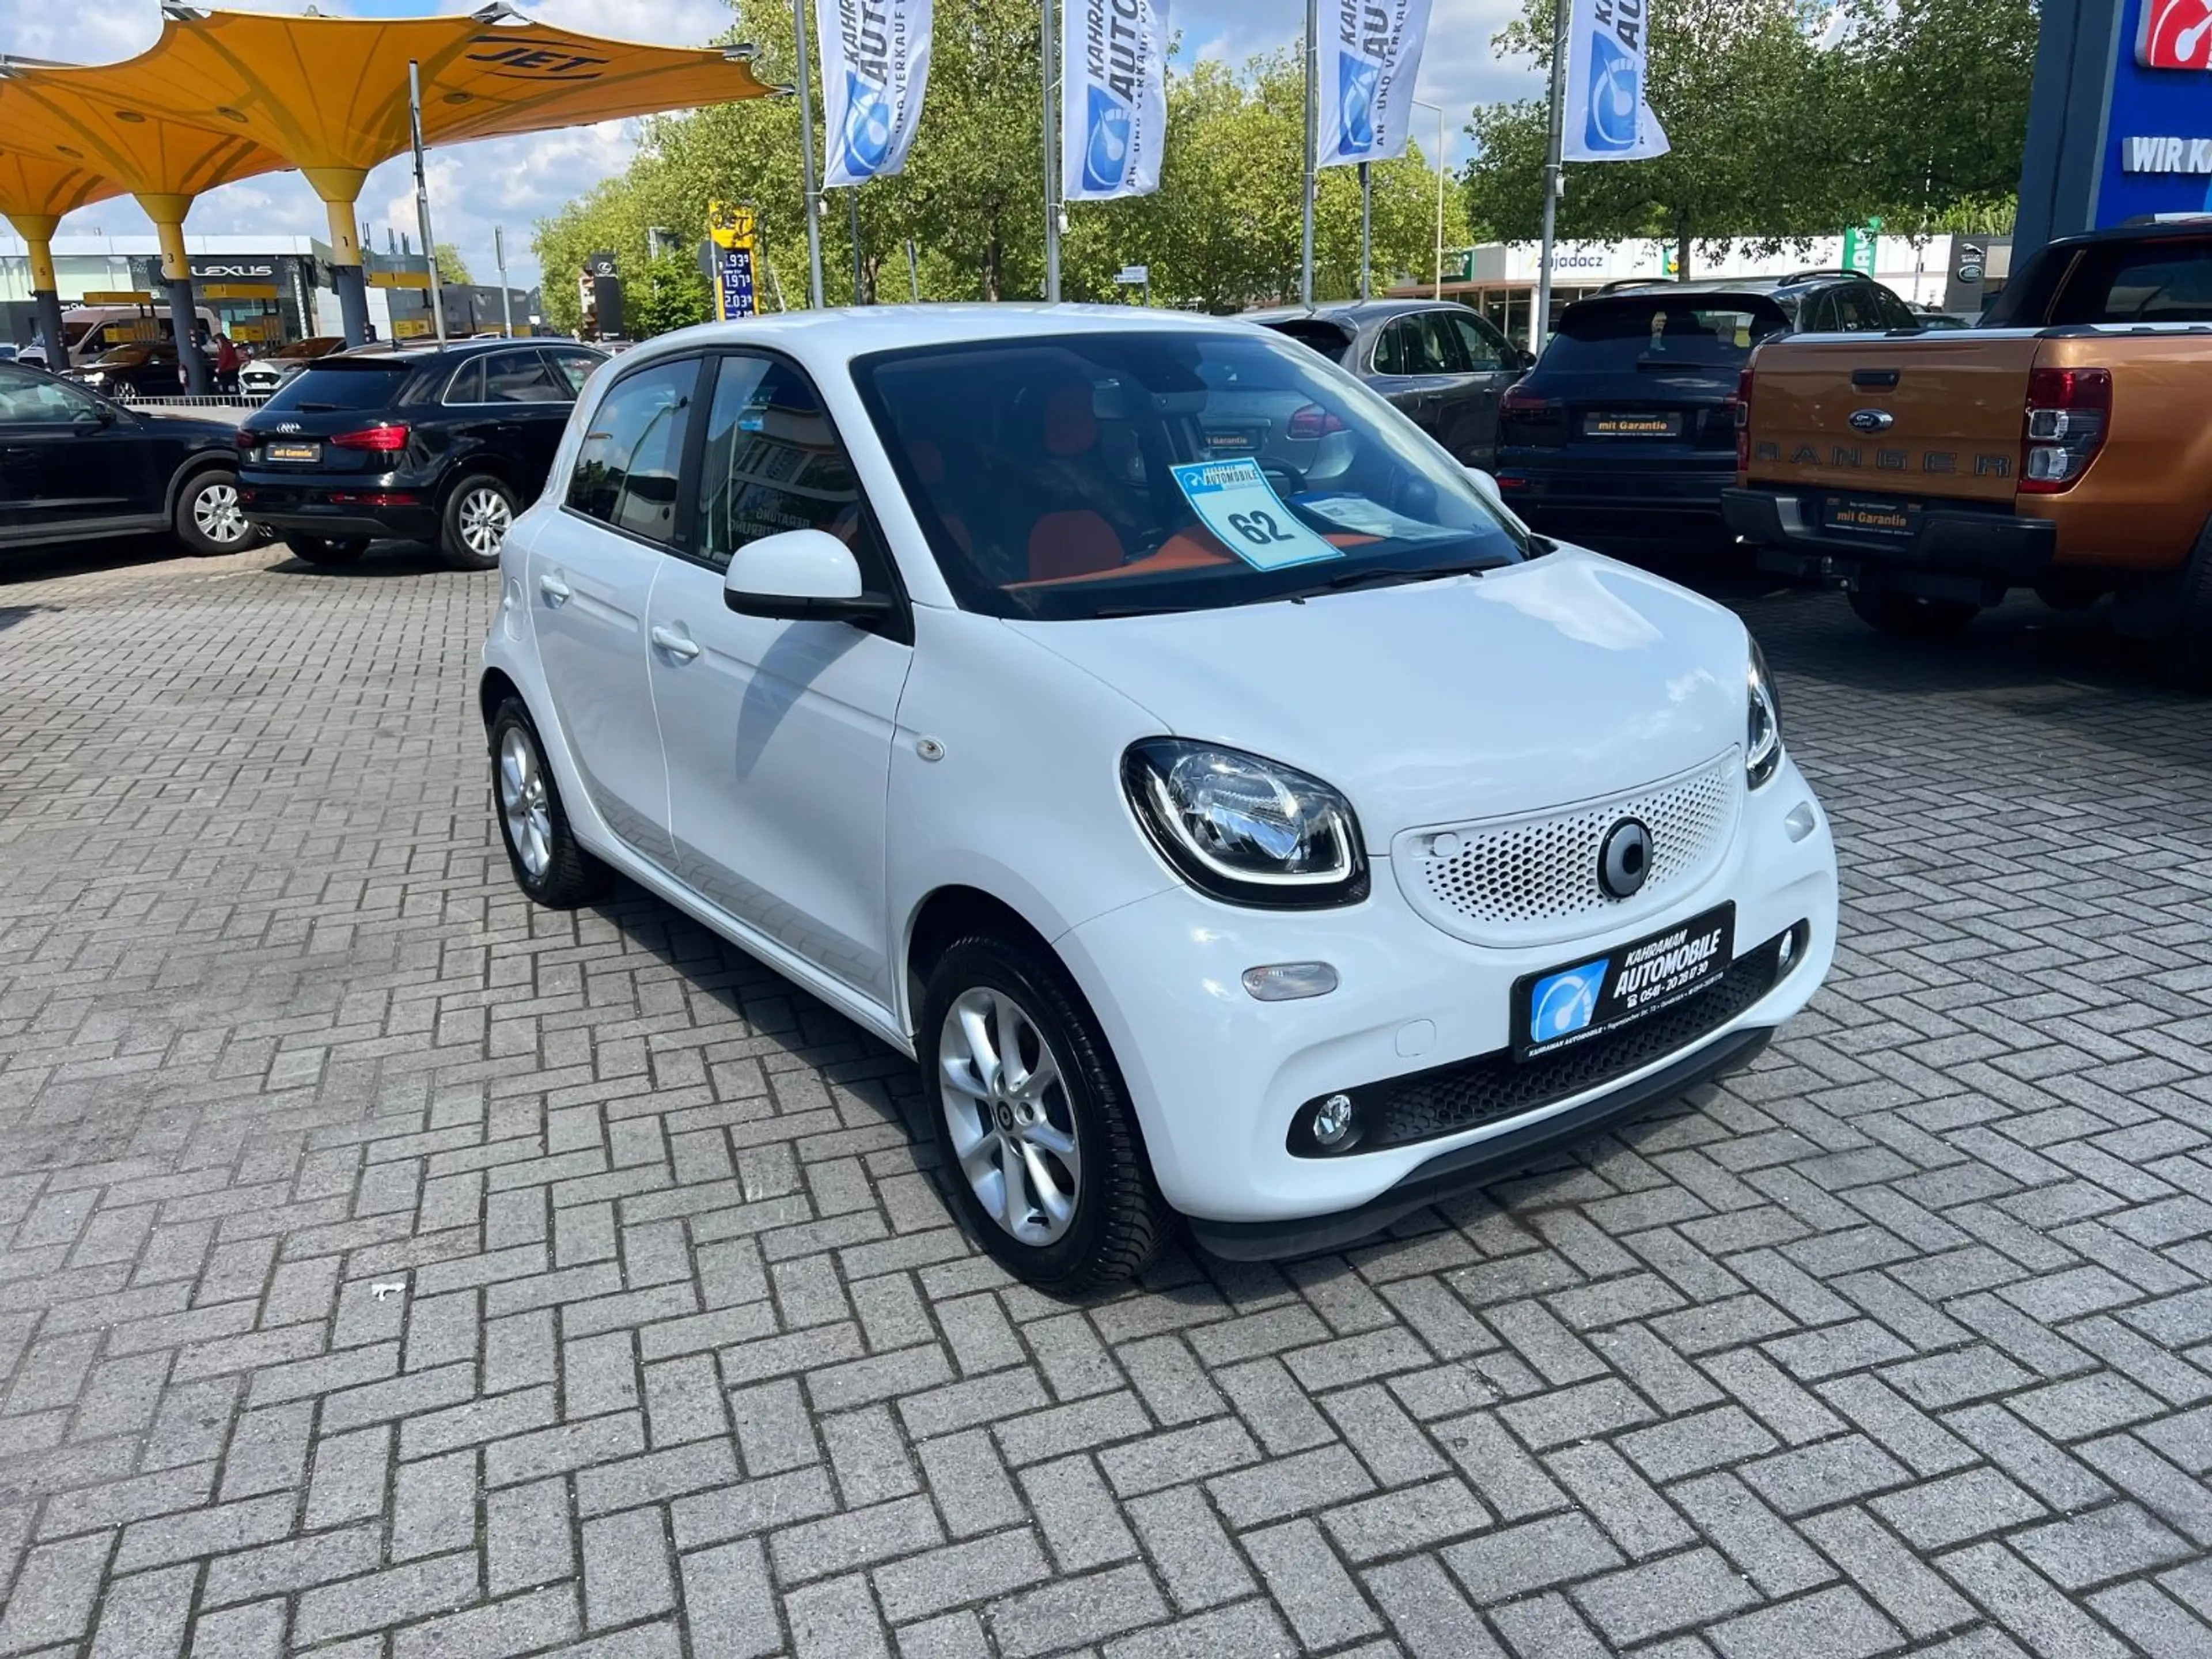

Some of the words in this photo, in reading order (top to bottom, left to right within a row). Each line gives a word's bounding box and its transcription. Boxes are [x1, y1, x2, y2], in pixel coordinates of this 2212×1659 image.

[861, 0, 888, 86] AUT
[895, 11, 906, 94] VERKAUF
[465, 48, 609, 71] JET
[2133, 137, 2184, 173] WIR
[2188, 138, 2212, 173] K
[167, 253, 175, 264] 3
[191, 265, 272, 276] LEXUS
[1537, 252, 1603, 272] zjadacz
[1598, 421, 1616, 430] mit
[1619, 421, 1667, 430] Garantie
[1755, 441, 2013, 478] RANGER
[1206, 469, 1258, 485] AUTOMOBILE
[1228, 510, 1296, 545] 62
[1836, 510, 1855, 522] mit
[1858, 511, 1907, 527] Garantie
[1624, 929, 1688, 968] KAHRAMAN
[1613, 928, 1722, 999] AUTOMOBILE
[1639, 983, 1662, 1003] 0541
[1665, 976, 1678, 991] 20
